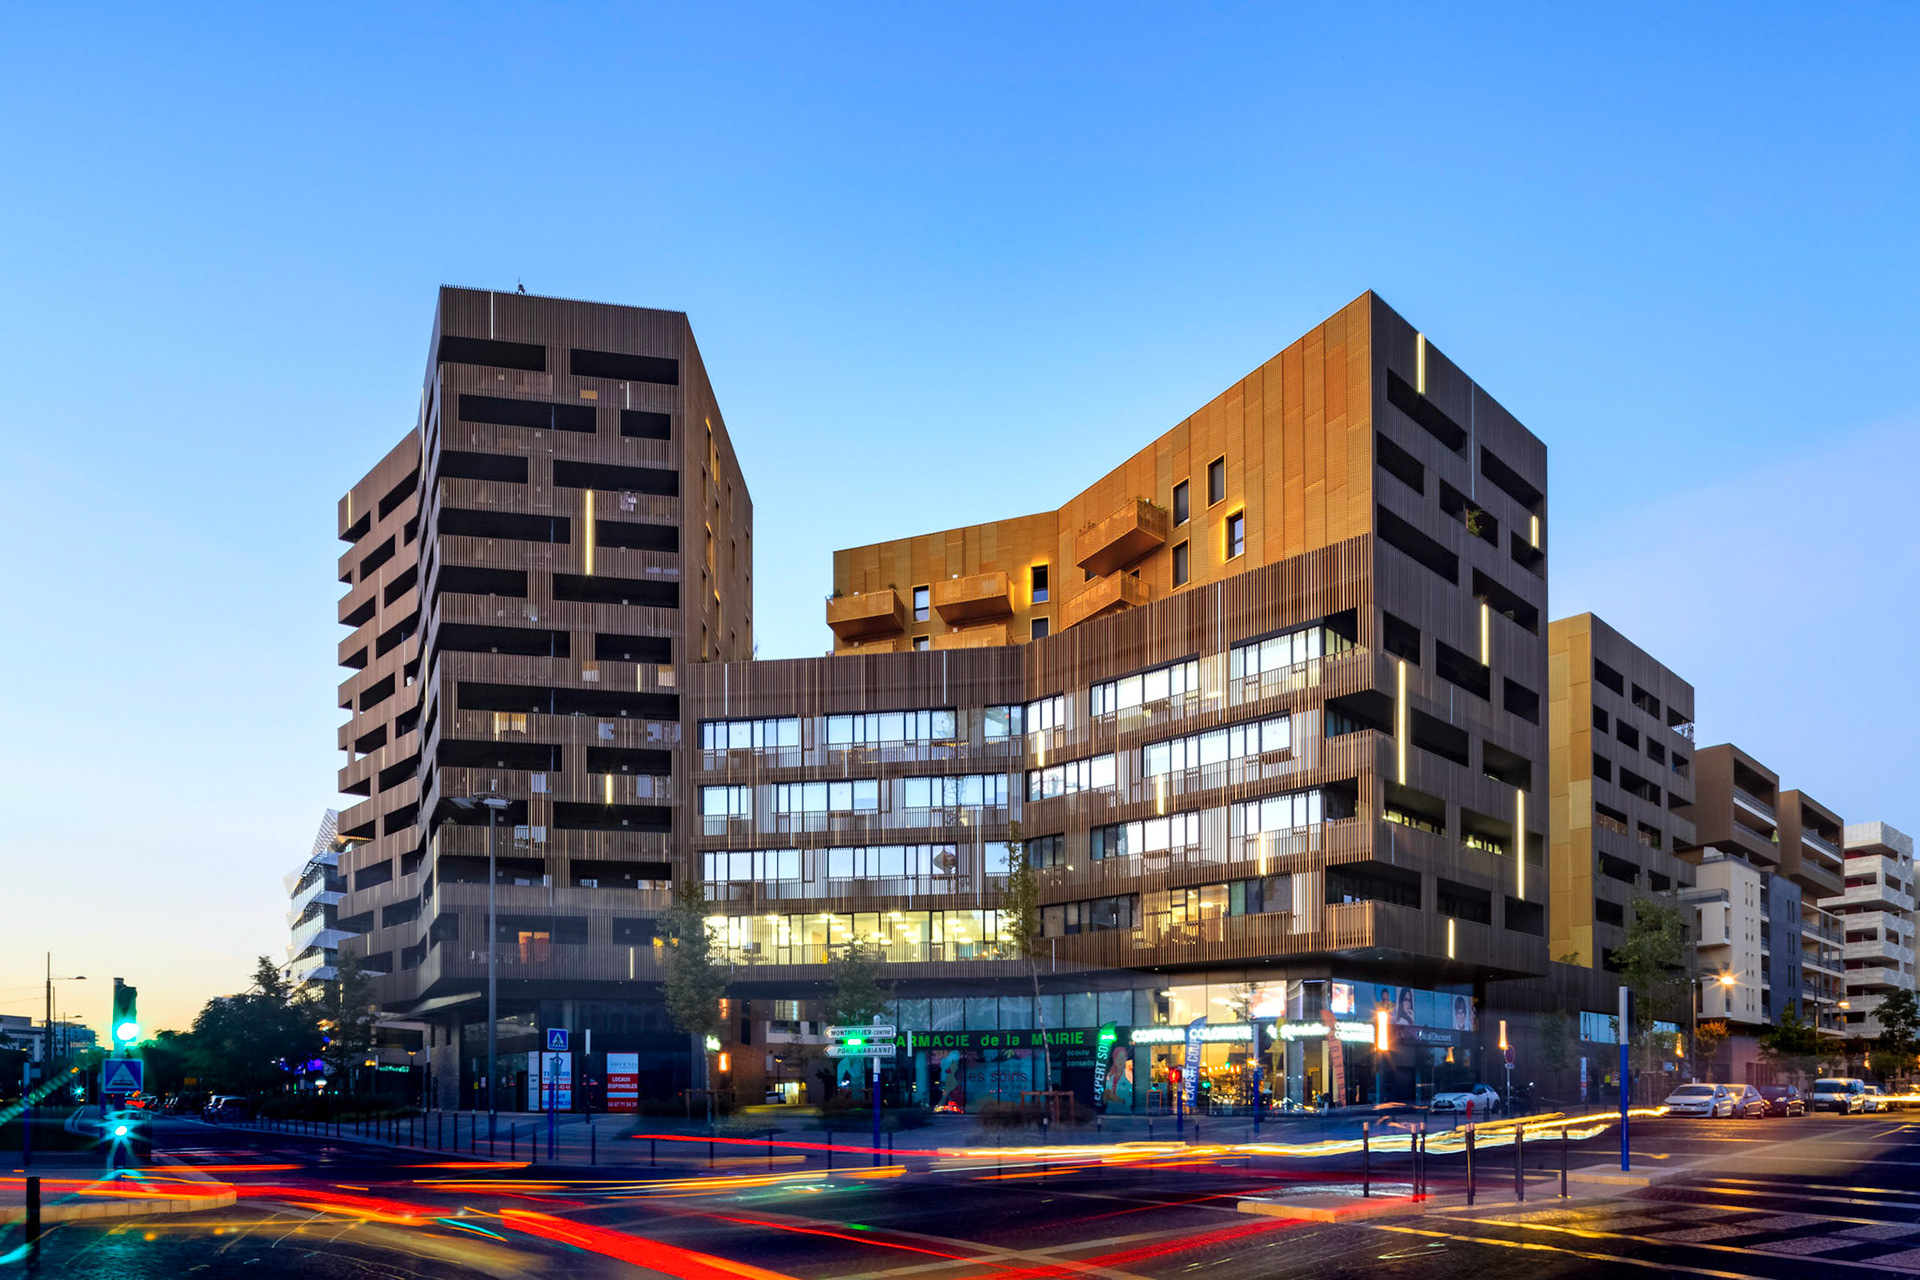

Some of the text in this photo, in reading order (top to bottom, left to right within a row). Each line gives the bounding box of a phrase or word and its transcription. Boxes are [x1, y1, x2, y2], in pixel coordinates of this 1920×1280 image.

[980, 1034, 1000, 1046] de
[1006, 1034, 1020, 1046] la
[1031, 1032, 1084, 1046] MAIRIE
[991, 1070, 1028, 1082] soins
